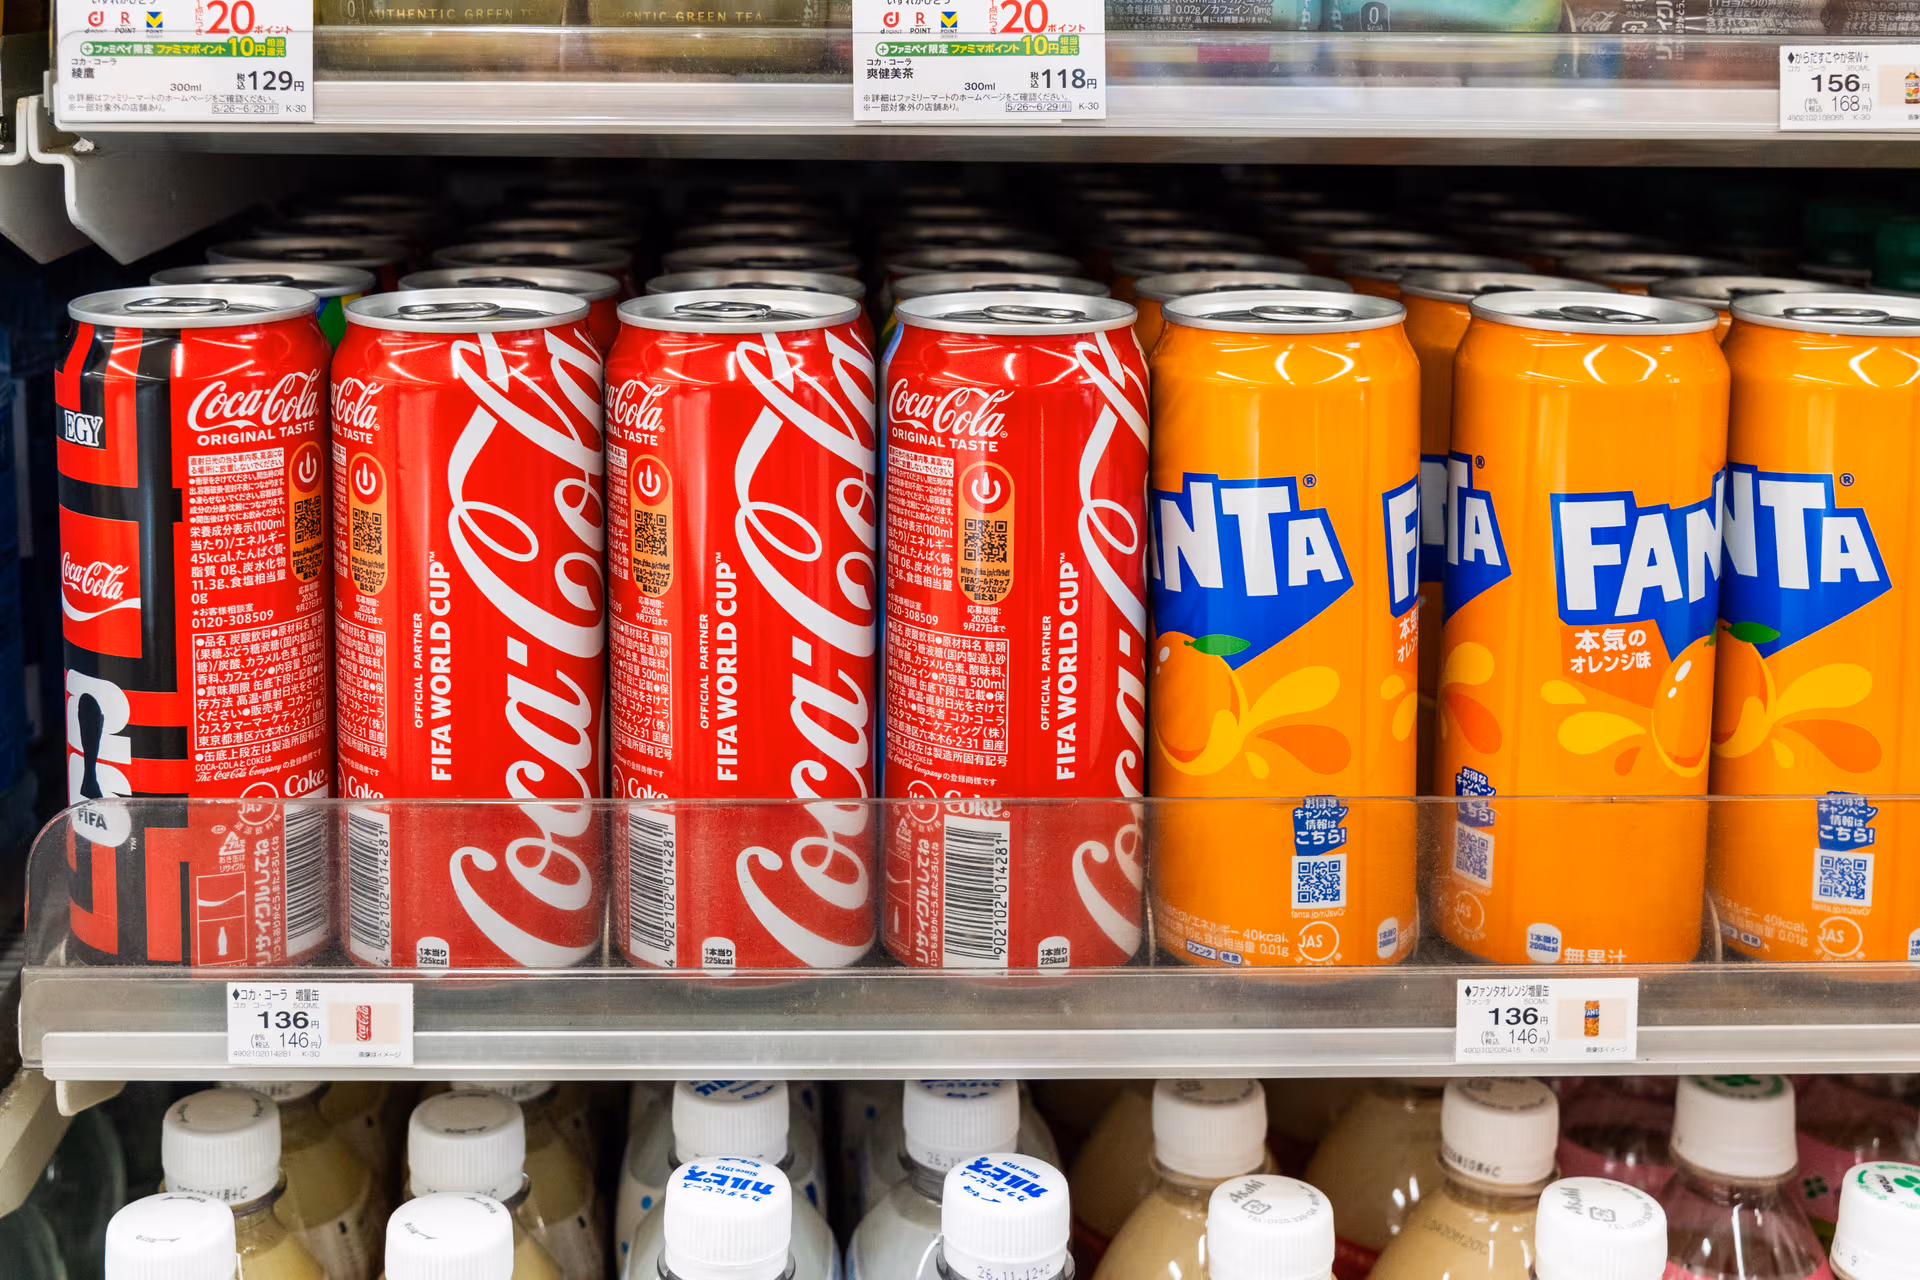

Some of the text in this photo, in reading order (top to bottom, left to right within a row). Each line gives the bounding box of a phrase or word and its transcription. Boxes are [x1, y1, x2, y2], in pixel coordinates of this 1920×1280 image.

[368, 8, 456, 20] AUTHENTIC
[464, 8, 512, 19] GREEN
[676, 11, 764, 22] GREEN TEA
[1369, 7, 1378, 24] 0
[94, 44, 154, 54] ファミペイ限定
[156, 44, 226, 54] ファミマポイント
[890, 36, 1058, 55] ファミペイ限定 ファミマポイント 10円
[1060, 37, 1078, 45] 相当
[1060, 46, 1078, 54] 還元
[71, 58, 116, 66] コカ・コーラ
[866, 58, 912, 66] コカ・コーラ
[72, 68, 95, 79] 綾鷹
[866, 68, 914, 80] 爽健美茶
[1030, 72, 1039, 88] 税込
[170, 84, 202, 92] 300ml
[964, 82, 996, 91] 300ml
[1811, 74, 1870, 92] 156円
[286, 104, 306, 112] K-30
[863, 103, 960, 112] ※一部対象外の店舗あり。
[1078, 102, 1100, 110] K-30
[1808, 105, 1822, 113] 税込
[187, 368, 322, 432] Coca-Cola
[889, 378, 1014, 438] Coca-Cola
[64, 410, 103, 446] EGY
[197, 428, 276, 446] ORIGINAL
[280, 420, 315, 438] TASTE
[343, 428, 374, 444] TASTE
[624, 429, 658, 446] TASTE
[892, 427, 998, 452] ORIGINAL TASTE
[190, 517, 285, 538] 栄養成分表示(100ml
[1723, 471, 1880, 590] NTA
[190, 534, 286, 551] 当たり)/エネルギー
[1154, 481, 1344, 596] NTA
[1560, 475, 1726, 616] FAN
[191, 565, 216, 578] 脂質
[220, 557, 286, 576] 0g、炭水化物
[900, 558, 953, 578] 0g、炭水化物
[62, 552, 130, 602] Coca-Cola
[192, 569, 286, 590] 11.3g、食塩相当量
[960, 576, 1010, 586] FIFAワールドカップ
[191, 593, 208, 604] 0g
[192, 610, 274, 628] 0120-308509
[636, 613, 668, 626] 9月27日まで
[888, 601, 939, 626] 0120-308509
[970, 614, 998, 624] 2026年
[963, 622, 1006, 633] 9月27日まで
[448, 328, 605, 968] Coca-Cola
[735, 328, 876, 968] Coca-Cola
[904, 627, 1006, 653] 炭酸飲料●原材料名 糖類
[1574, 628, 1647, 653] 本気の
[414, 612, 422, 728] OFFICIAL PARTNER
[1570, 650, 1652, 674] オレンジ味
[359, 666, 384, 682] 500ml
[430, 624, 451, 720] WORLD
[642, 667, 669, 683] 500ml
[700, 614, 709, 729] OFFICIAL PARTNER
[716, 625, 738, 720] WORLD
[1041, 616, 1052, 730] OFFICIAL PARTNER
[1058, 622, 1078, 723] WORLD
[919, 680, 1006, 702] 缶底下段に記載●保
[970, 678, 1006, 690] 500ml
[198, 698, 233, 710] 存方法
[198, 700, 284, 722] ください●販売者
[630, 700, 669, 719] コカ・コーラ
[907, 691, 1006, 714] 高温・直射日光をさけて
[888, 704, 1006, 740] カスタマーマーケティング(株)
[950, 711, 1006, 726] コカ・コーラ
[198, 716, 310, 747] 東京都港区六本木6-2-31
[368, 729, 385, 743] 国産
[652, 730, 670, 744] 国産
[888, 716, 1005, 752] 東京都港区六本木6-2-31 国産
[430, 724, 452, 781] FIFA
[717, 726, 738, 781] FIFA
[1057, 726, 1076, 780] FIFA
[196, 755, 272, 772] COCA-COLAとCOKEは
[284, 768, 325, 797] Coke
[942, 772, 997, 787] の登録商標です
[1456, 774, 1496, 796] キャンペーン
[1462, 768, 1488, 785] お得な
[1294, 805, 1349, 819] キャンペーン
[1820, 804, 1878, 816] キャンペーン
[78, 808, 108, 832] FIFA
[1305, 820, 1337, 830] 情報は
[1830, 815, 1864, 827] 情報は
[1296, 829, 1346, 845] こちら!
[1819, 825, 1875, 844] こちら!
[664, 830, 675, 948] 902102 014281
[994, 838, 1008, 955] 902102 014281
[916, 838, 930, 964] リサイクルしてね
[380, 888, 390, 947] 902102
[1298, 934, 1324, 948] JAS
[1530, 933, 1558, 944] 1本当り
[1778, 930, 1808, 946] 0.01g
[1818, 929, 1844, 943] JAS
[418, 948, 447, 958] 1本当り
[704, 948, 733, 958] 1本当り
[1040, 948, 1068, 958] 1本当り
[1259, 942, 1290, 957] 0.01g
[1530, 942, 1558, 953] 200kcal
[1564, 946, 1627, 963] 無果汁
[418, 957, 448, 966] 225kcal
[704, 956, 734, 966] 225kcal
[1040, 956, 1068, 966] 225kcal
[296, 988, 320, 1002] 増量缶
[258, 1010, 320, 1030] 136円
[1488, 1006, 1548, 1026] 136円
[255, 1041, 270, 1049] 税込
[1485, 1038, 1500, 1046] 税込
[1530, 1046, 1548, 1054] K-30
[233, 1050, 320, 1058] 4902102014281 K-30
[735, 1168, 758, 1176] Since
[1002, 1161, 1041, 1179] Since 1919
[683, 1169, 775, 1195] カルピス
[966, 1160, 1048, 1198] カルピス
[1229, 1179, 1266, 1204] Asahi
[1560, 1186, 1584, 1216] Asahi
